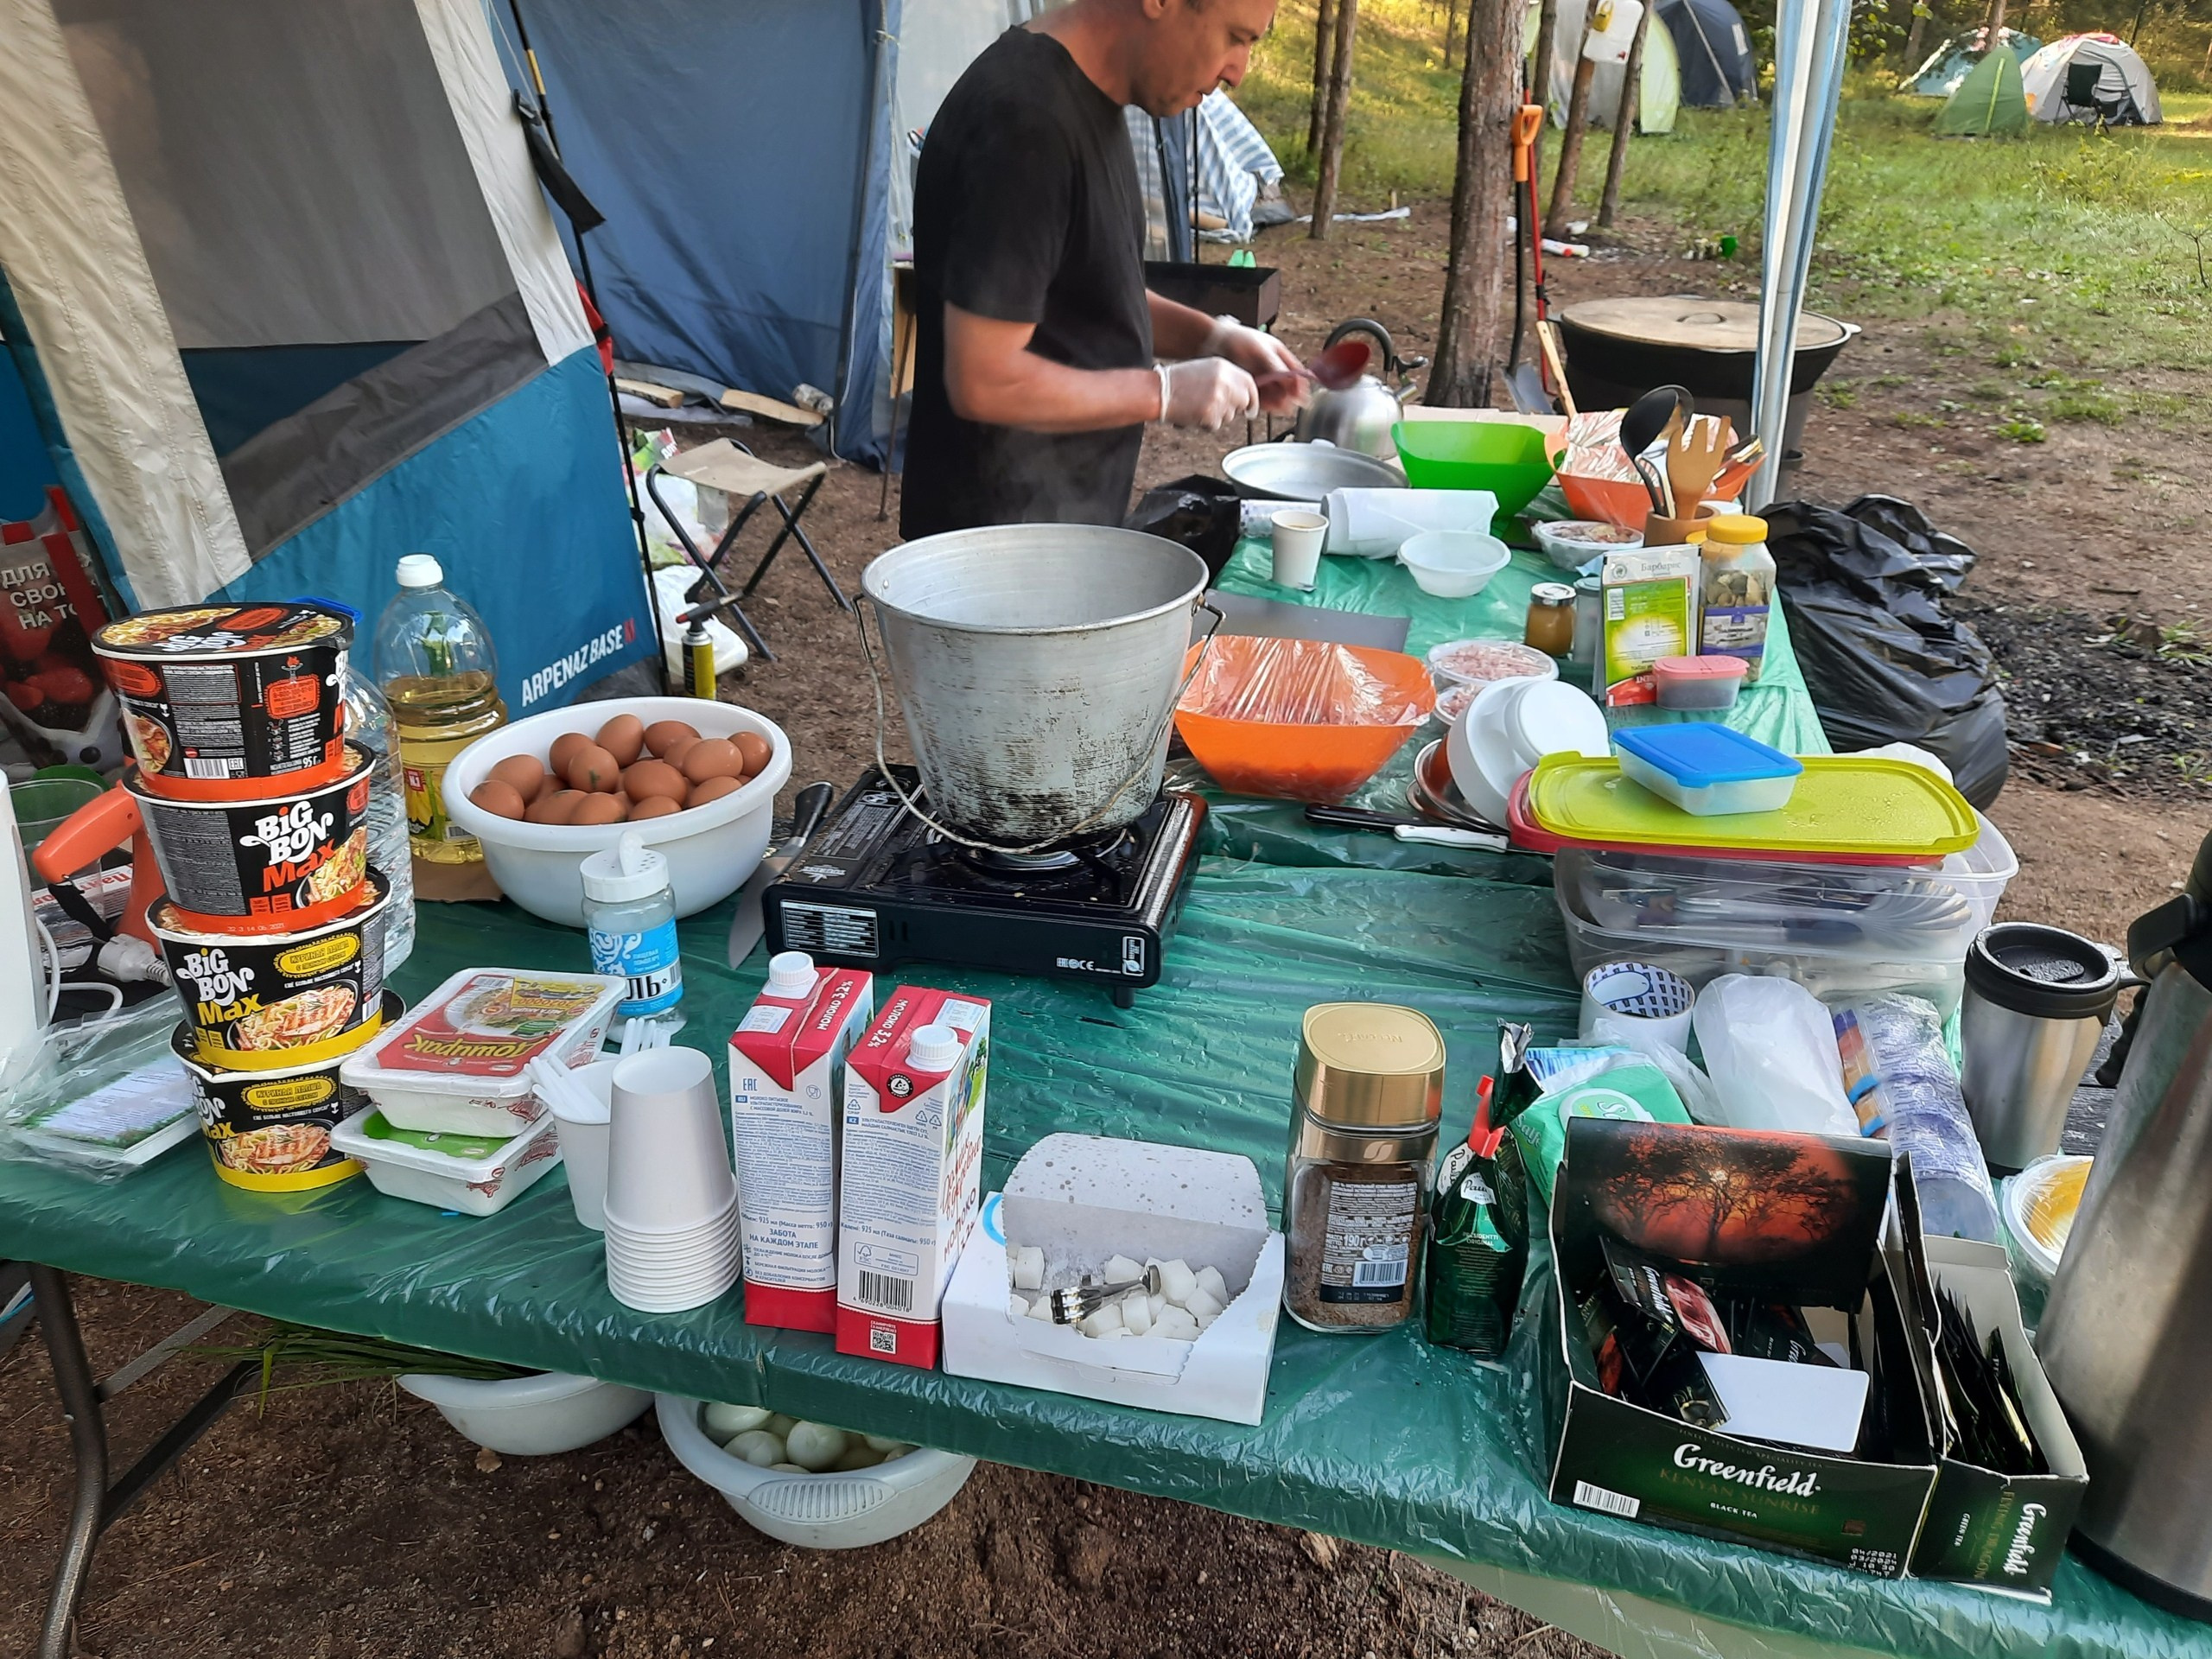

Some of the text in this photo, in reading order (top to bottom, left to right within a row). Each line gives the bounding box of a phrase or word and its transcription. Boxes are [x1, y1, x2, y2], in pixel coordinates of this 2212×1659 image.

[2, 563, 50, 588] ДЛЯ
[19, 611, 52, 630] НА
[522, 645, 589, 707] ARPENAZ
[589, 624, 624, 664] BASE
[302, 757, 312, 768] 95
[239, 812, 334, 865] BON
[263, 838, 335, 892] Max
[175, 968, 255, 1006] BON
[626, 976, 661, 1000] ЛЬ
[197, 994, 265, 1026] Max
[817, 980, 854, 1031] МОЛОКО 3,2%
[868, 999, 908, 1048] МОЛОКО 3,2%
[404, 1034, 549, 1058] Доширак
[256, 1088, 293, 1098] КУРИНАЯ
[759, 1217, 769, 1225] 925
[779, 1219, 797, 1228] (Масса
[770, 1228, 797, 1238] ЗАБОТА
[944, 1187, 976, 1262] МОЛОКО
[749, 1233, 759, 1242] НА
[760, 1236, 794, 1247] КАЖДОМ
[1674, 1443, 1821, 1497] Greenfield
[1659, 1468, 1820, 1515] KENYAN SUNRISE
[1710, 1502, 1758, 1519] BLACK TEA
[1954, 1513, 1971, 1547] GREEN TEA
[1974, 1491, 2015, 1580] FLYING DRAGON
[2002, 1503, 2047, 1576] Greenfield
